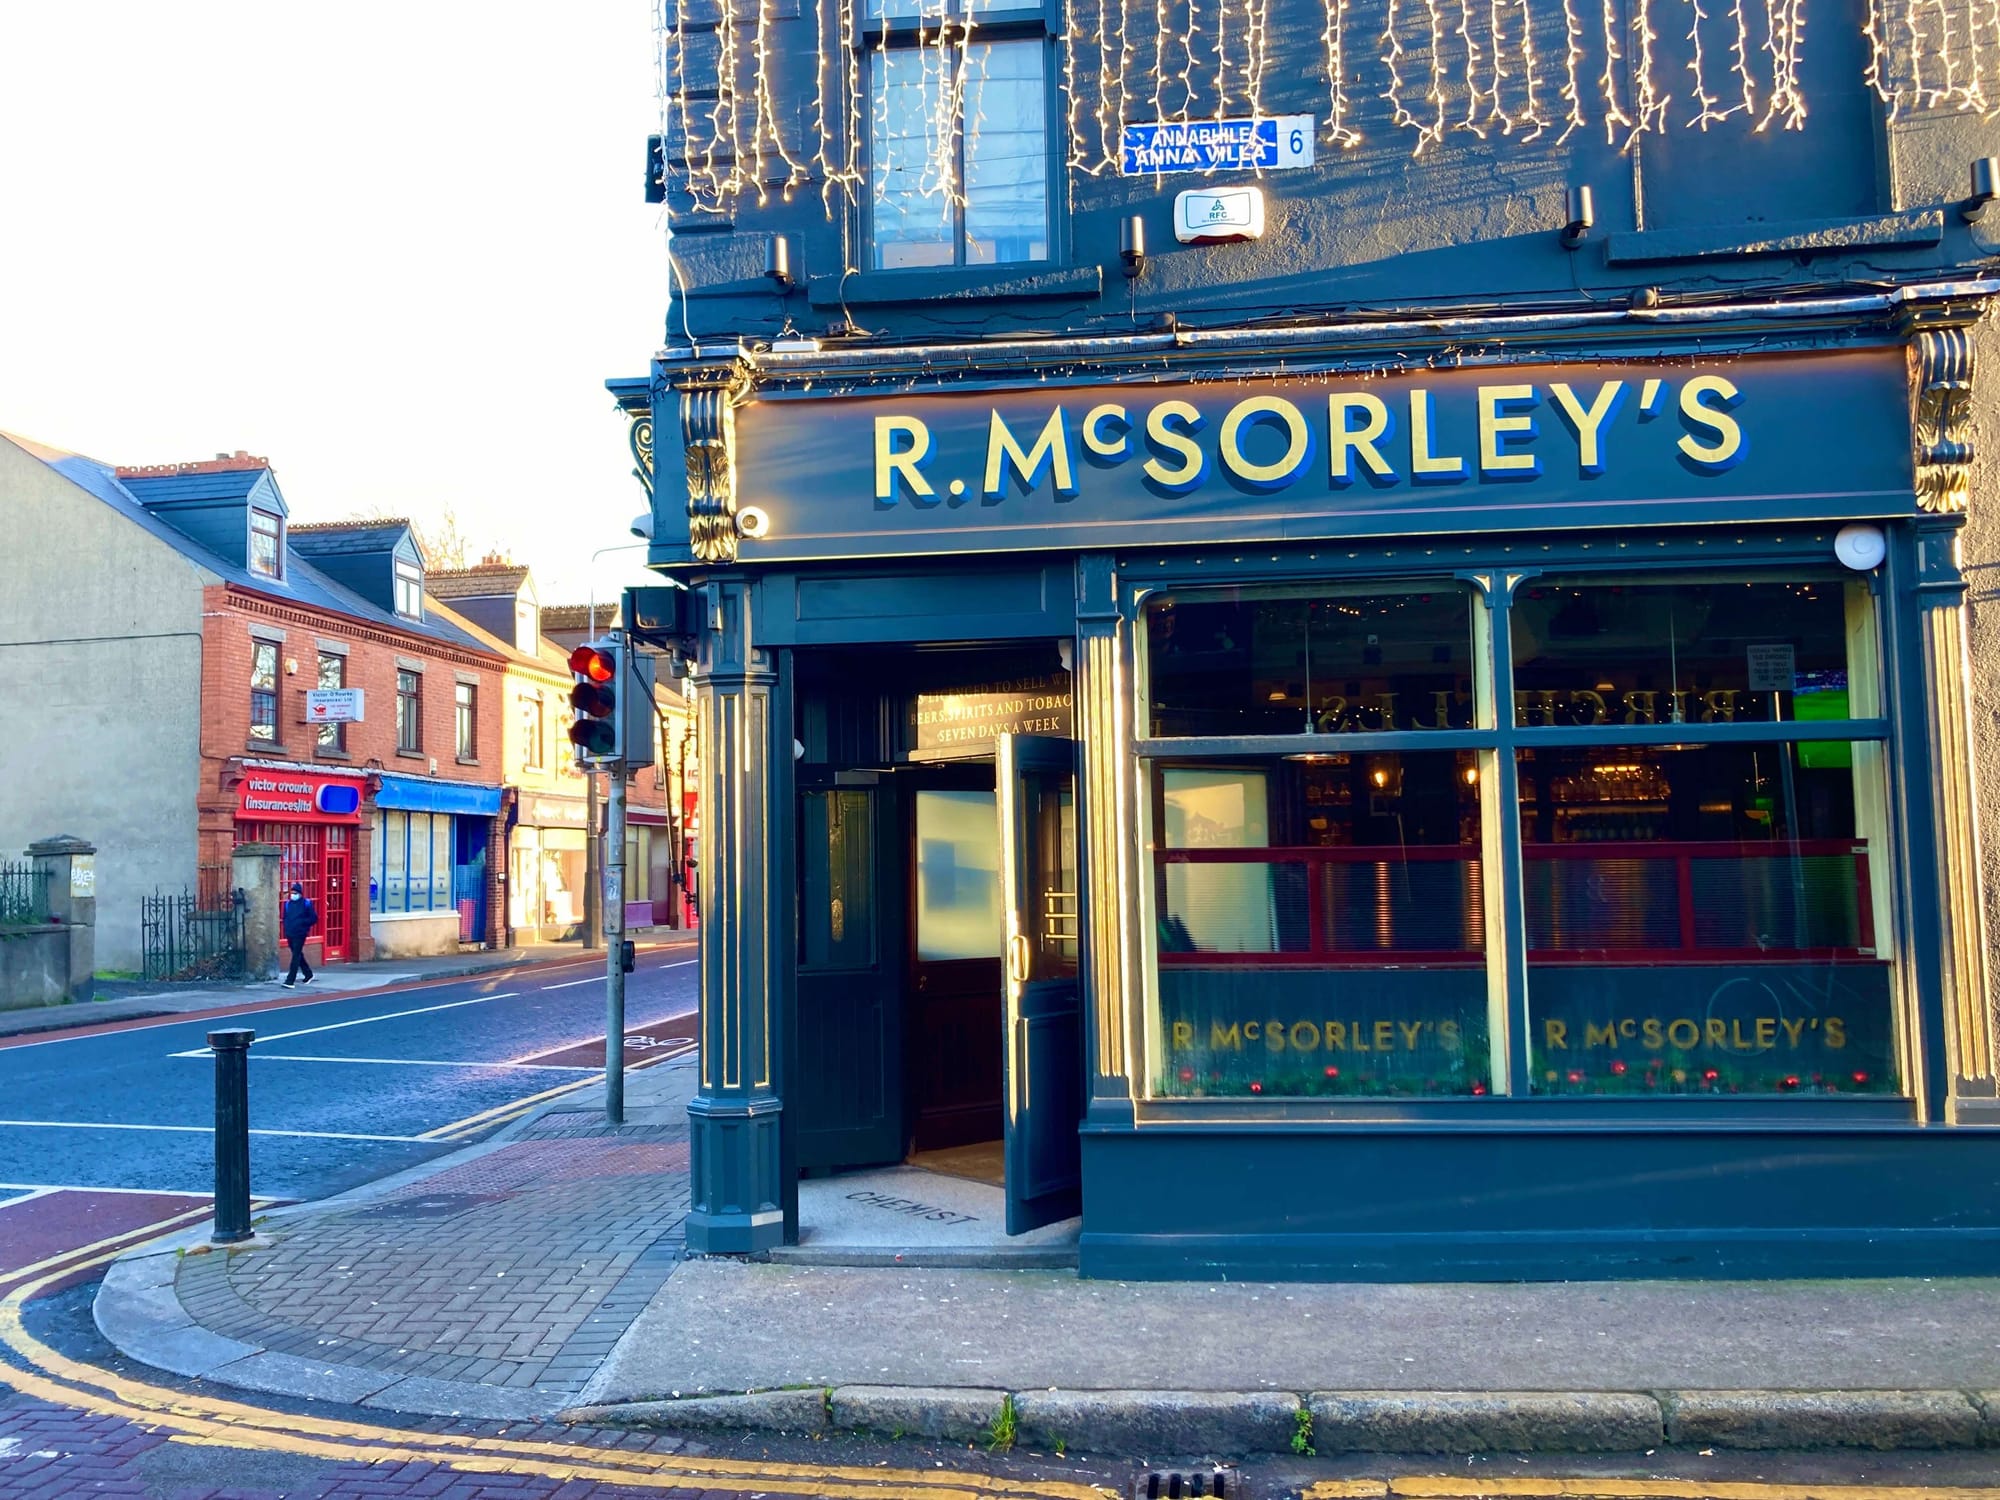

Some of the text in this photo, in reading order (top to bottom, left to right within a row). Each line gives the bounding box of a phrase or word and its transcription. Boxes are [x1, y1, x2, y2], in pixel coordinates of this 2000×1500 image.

[1289, 129, 1304, 154] 6
[1135, 144, 1267, 166] ANNA VILLA
[1209, 211, 1227, 219] RFC
[994, 680, 1011, 693] TO
[1016, 675, 1046, 691] SELL
[994, 701, 1023, 715] AND
[1026, 693, 1072, 712] TOBAC
[937, 716, 1060, 743] SEVEN DAYS A WEEK
[249, 777, 276, 791] victor
[1172, 1020, 1194, 1050] R
[1545, 1019, 1568, 1050] R
[845, 1190, 981, 1226] CHEMIST
